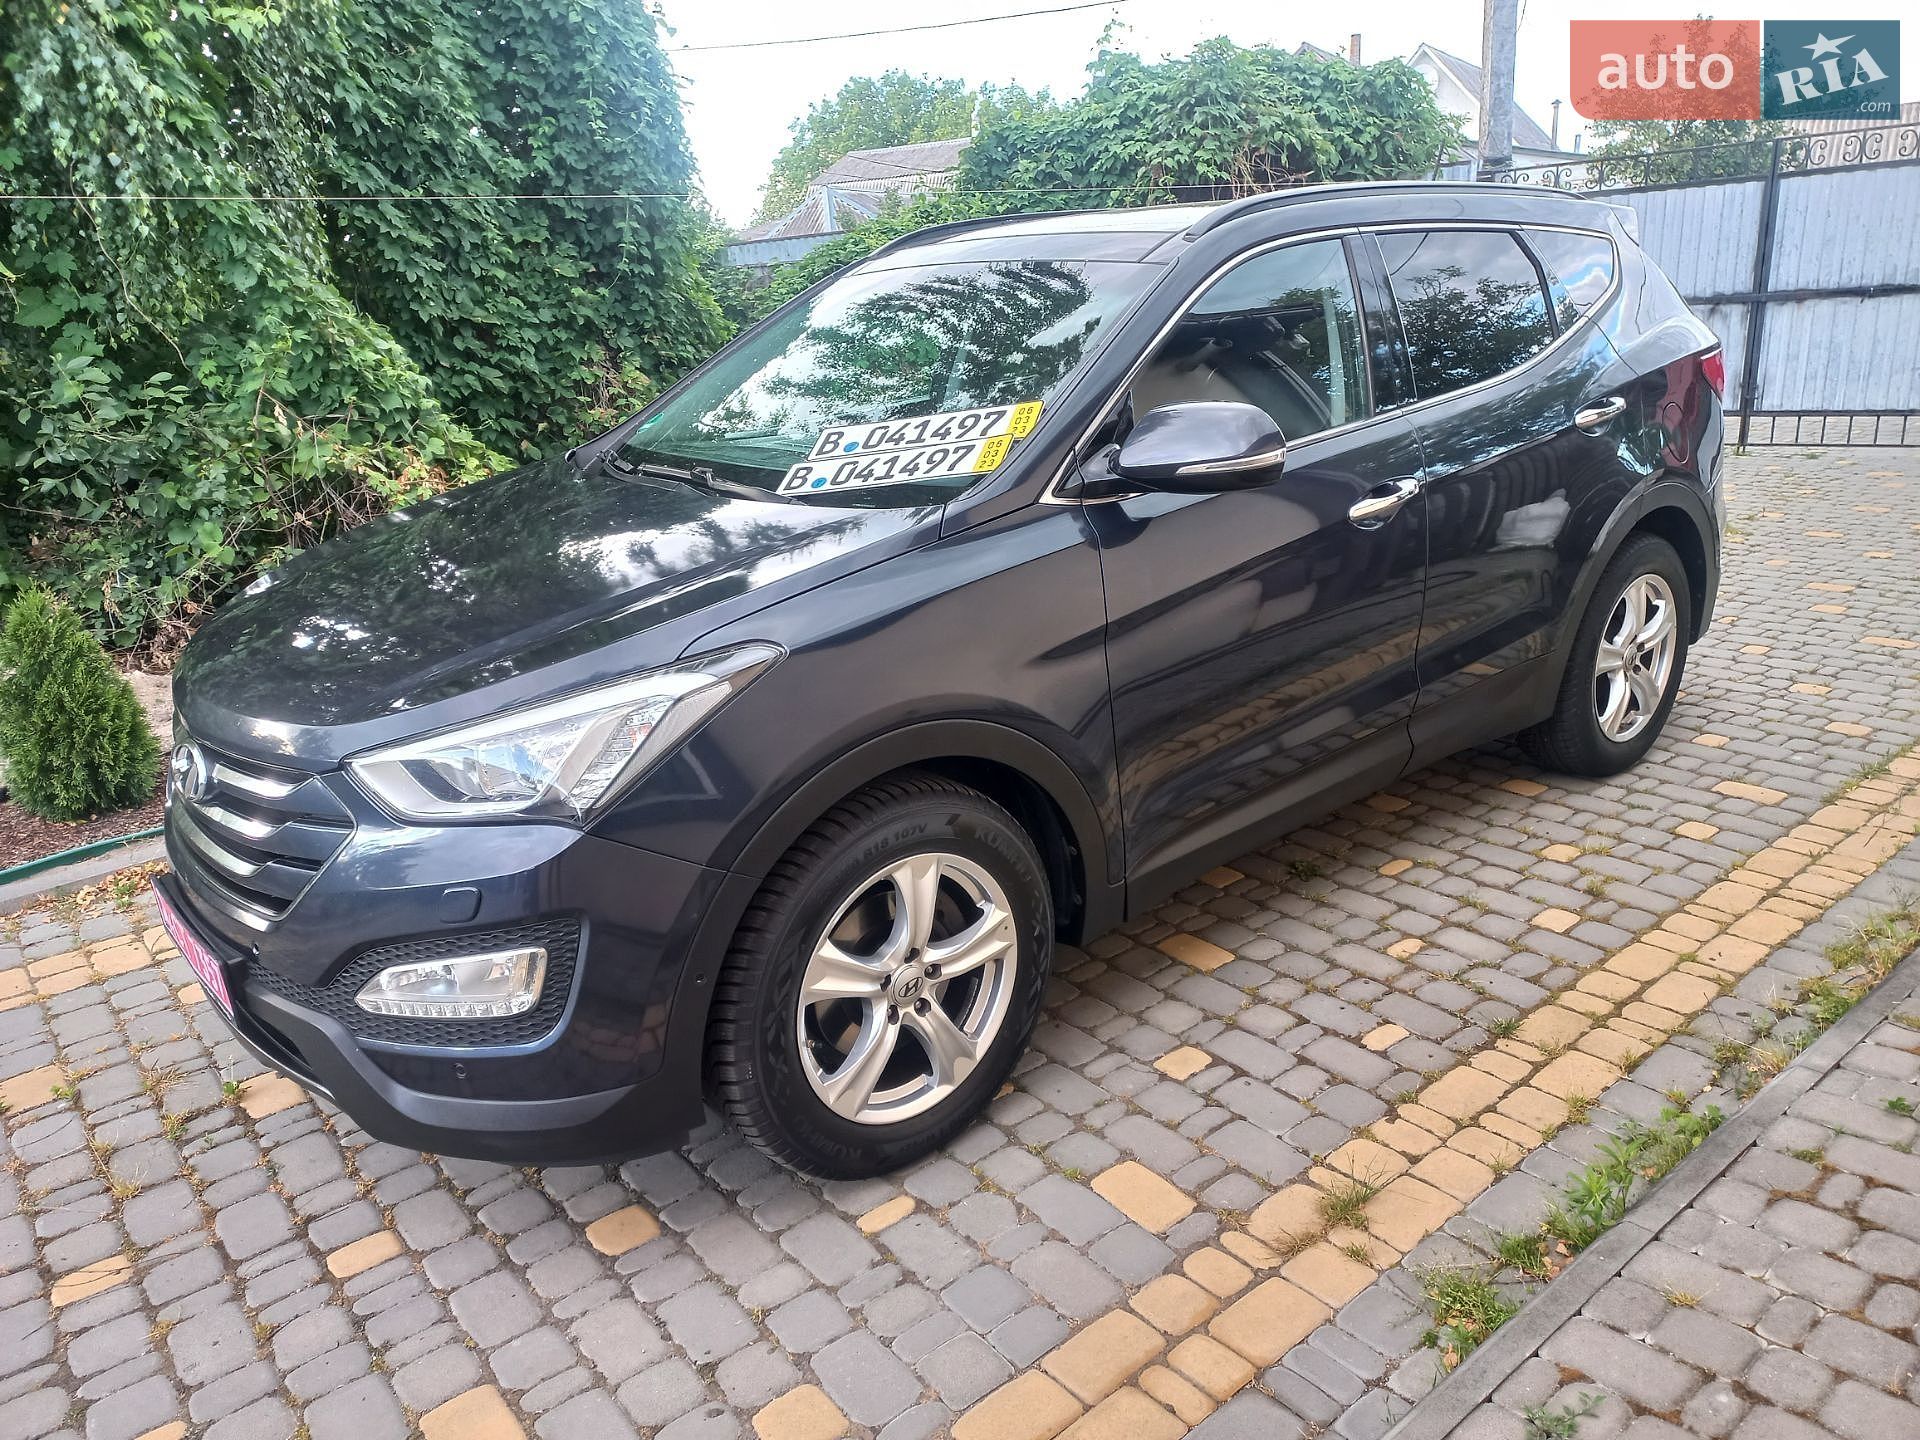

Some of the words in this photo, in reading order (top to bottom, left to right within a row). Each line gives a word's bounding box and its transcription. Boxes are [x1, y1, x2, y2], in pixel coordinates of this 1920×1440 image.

[1014, 415, 1030, 425] 03
[815, 431, 844, 456] B
[861, 410, 1008, 450] 041497
[987, 439, 1003, 449] 06
[983, 449, 999, 459] 03
[782, 466, 814, 491] B
[829, 445, 976, 486] 041497
